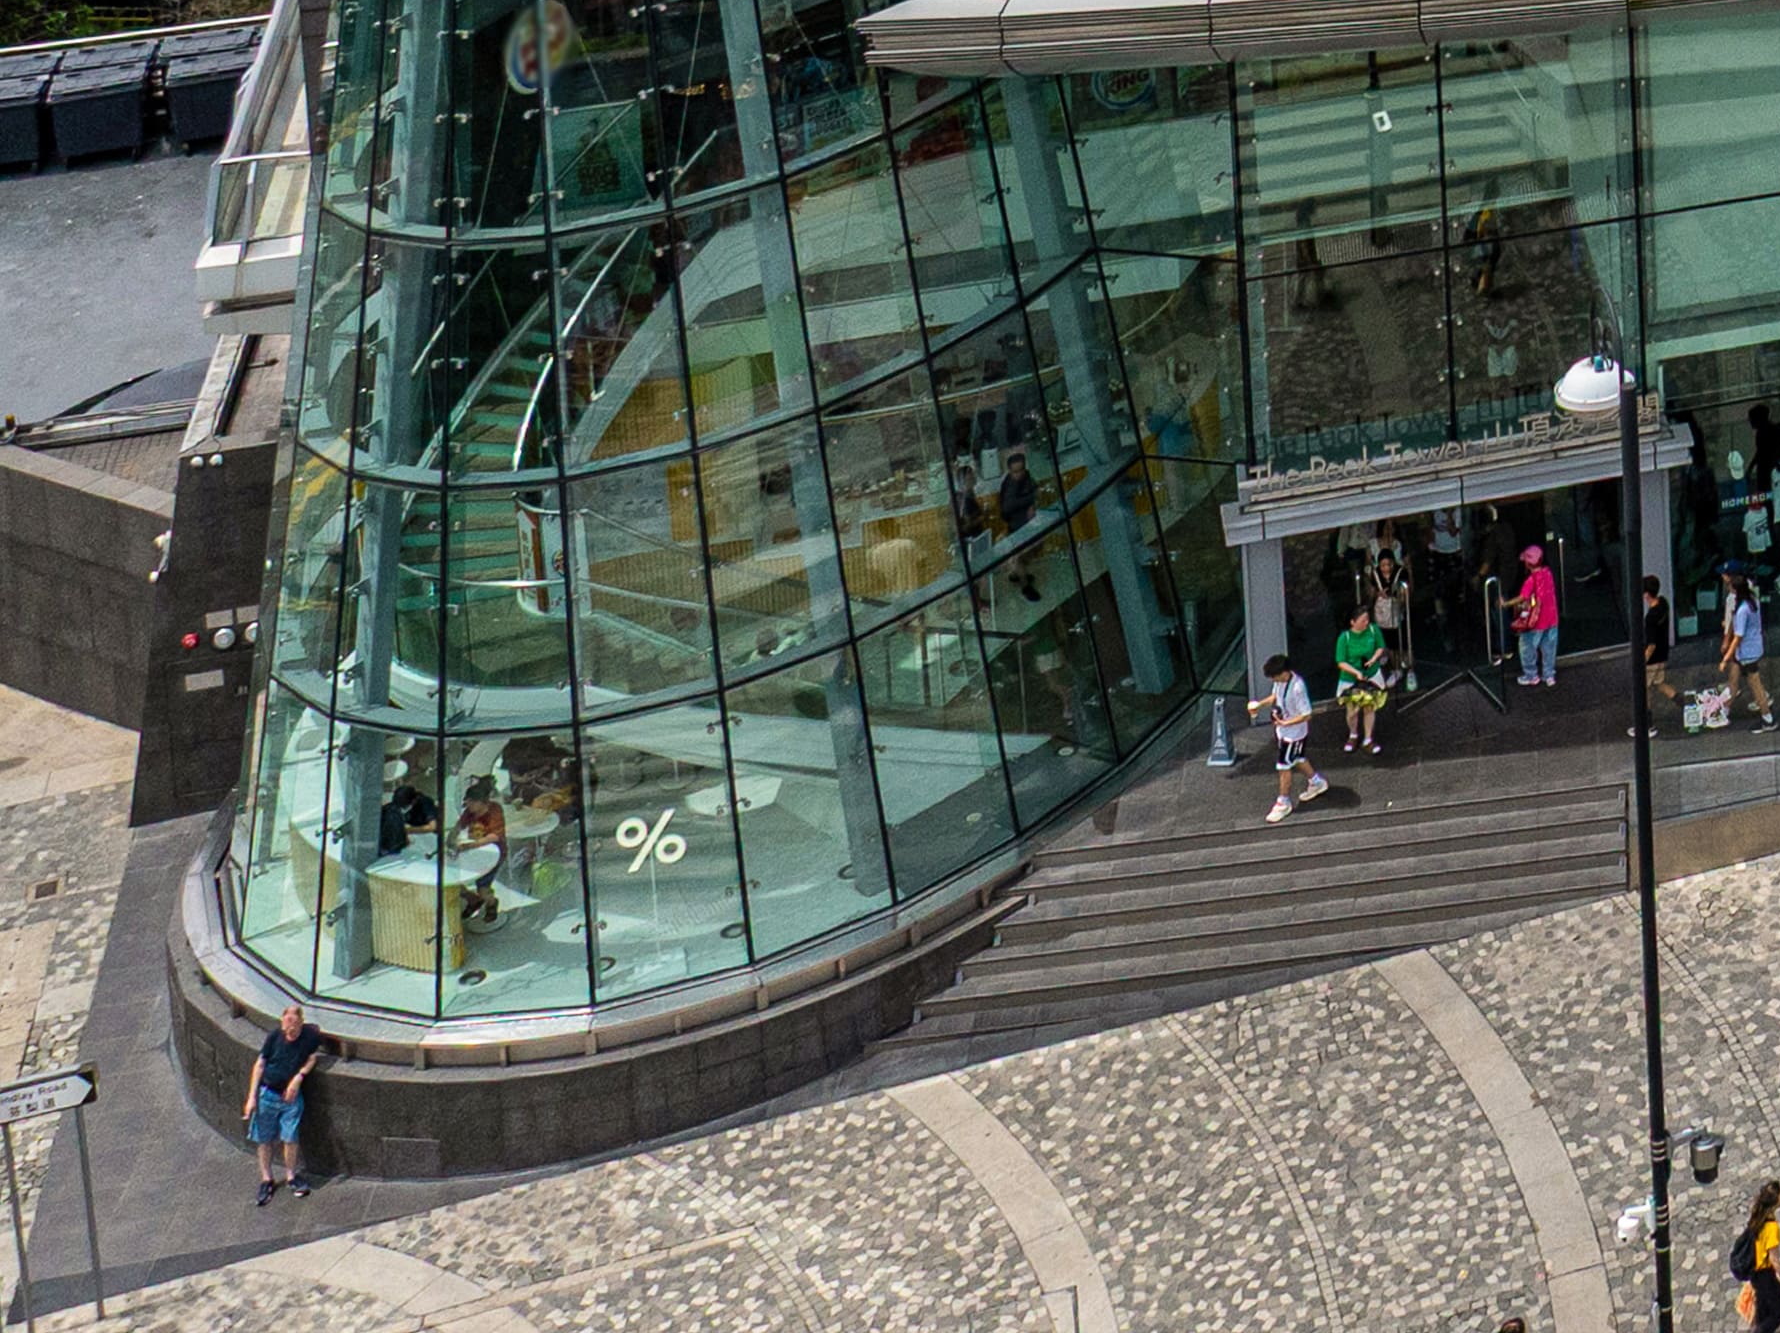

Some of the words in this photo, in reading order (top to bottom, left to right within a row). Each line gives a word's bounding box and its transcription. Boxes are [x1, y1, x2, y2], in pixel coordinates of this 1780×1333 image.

[1250, 456, 1300, 490] The
[1310, 445, 1377, 482] Peak
[1384, 441, 1472, 468] Tower
[616, 808, 687, 873] %
[38, 1081, 68, 1095] Road
